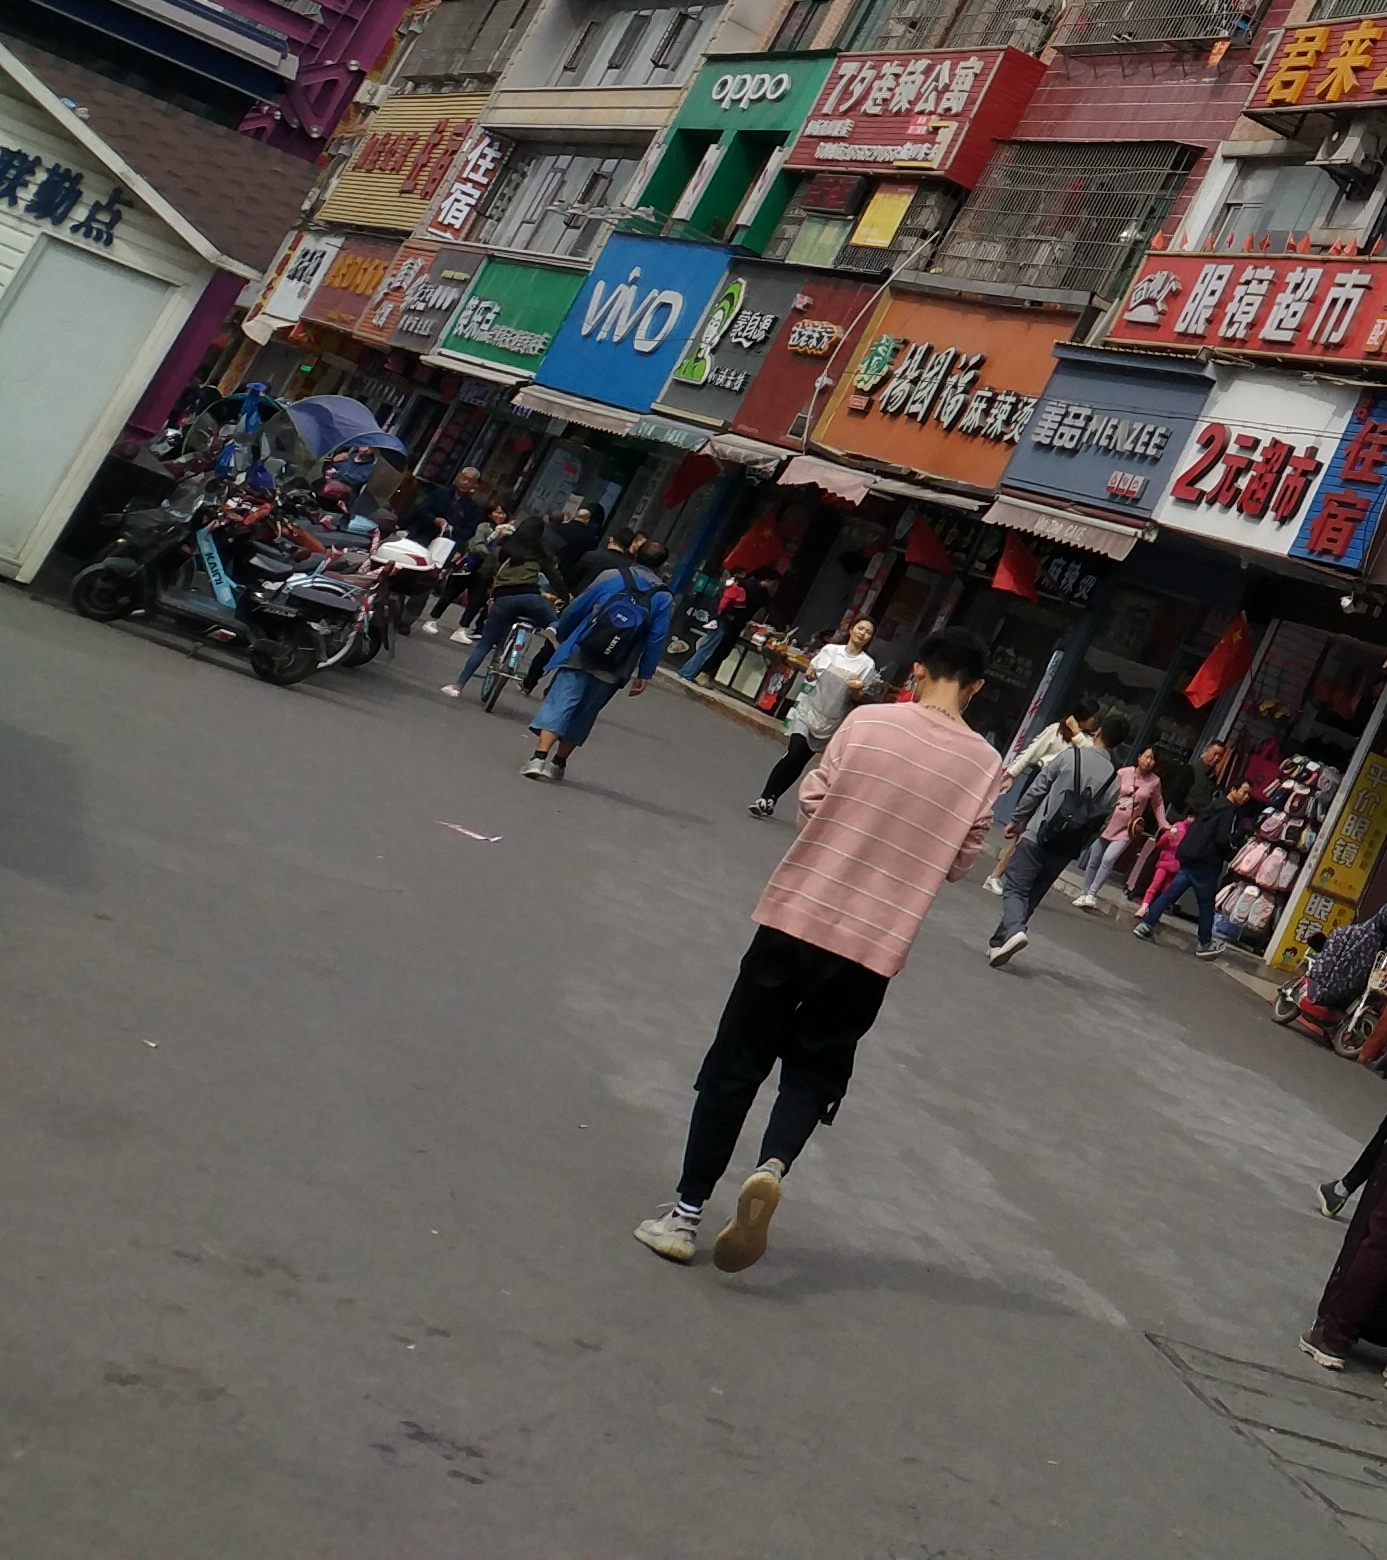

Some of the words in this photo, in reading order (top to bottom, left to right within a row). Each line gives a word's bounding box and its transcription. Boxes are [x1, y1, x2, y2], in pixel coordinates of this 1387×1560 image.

[711, 72, 792, 110] oppo
[438, 136, 503, 230] 住宿
[1172, 263, 1373, 345] 眼镜超市
[1170, 422, 1324, 523] 2元超市
